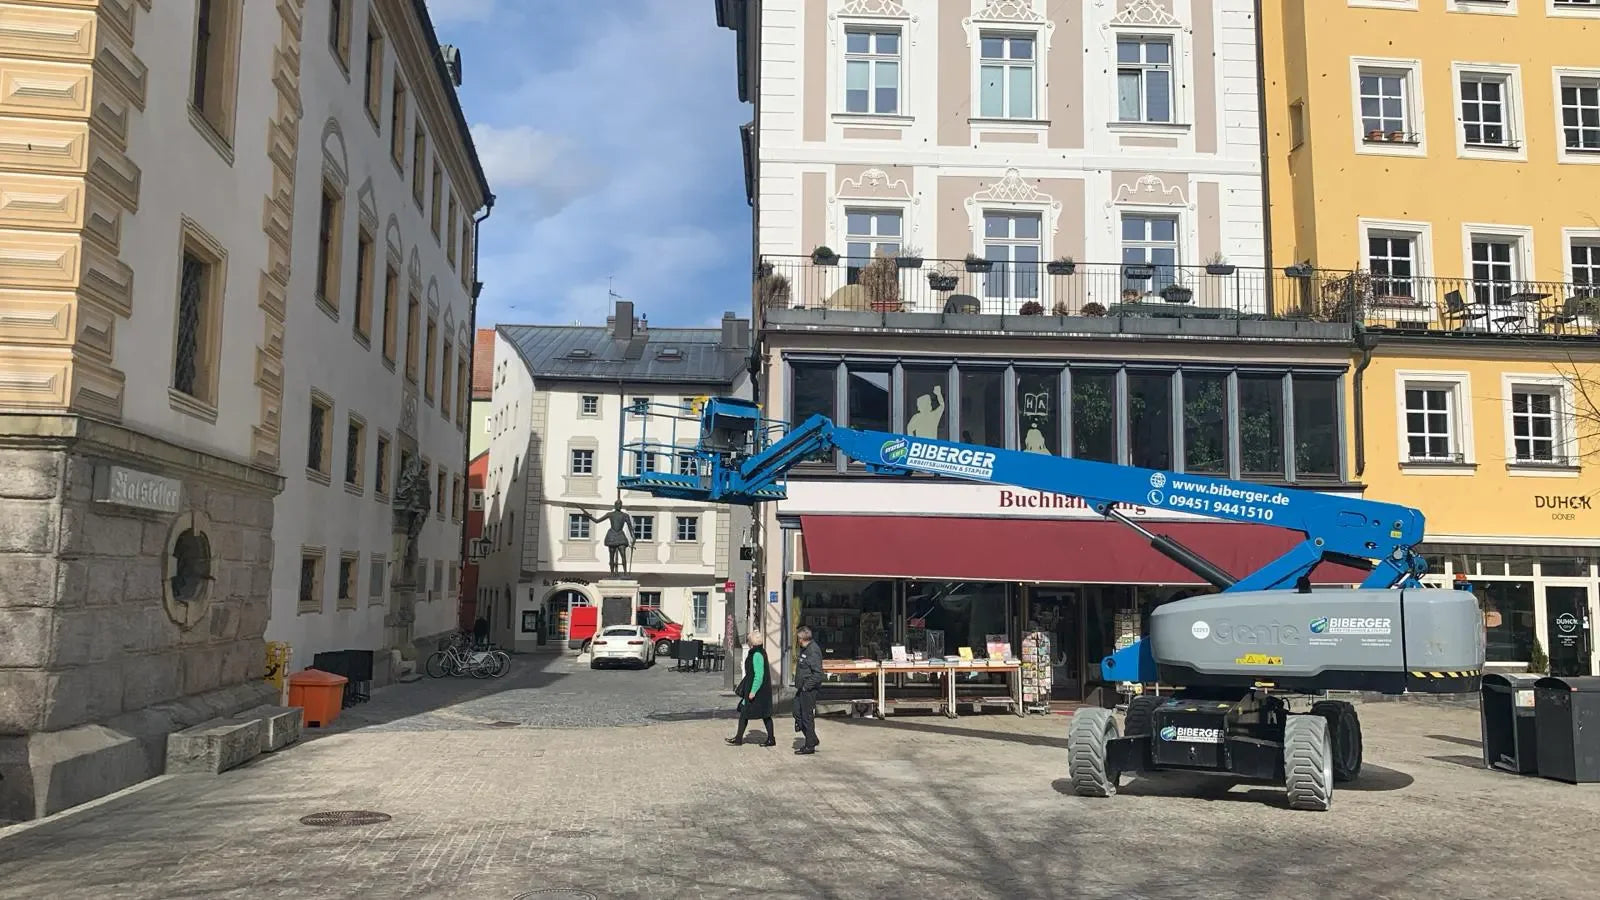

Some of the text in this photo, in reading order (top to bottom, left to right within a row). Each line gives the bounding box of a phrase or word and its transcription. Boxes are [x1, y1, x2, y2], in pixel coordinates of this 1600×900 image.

[909, 442, 996, 468] BIBERGER
[964, 467, 990, 476] STAPLER
[1172, 480, 1290, 506] www.biberger.de
[1169, 494, 1274, 521] 09451 9441510
[1210, 618, 1301, 647] Genie
[1329, 617, 1392, 628] BIBERGER
[1177, 727, 1225, 738] BIBERGER
